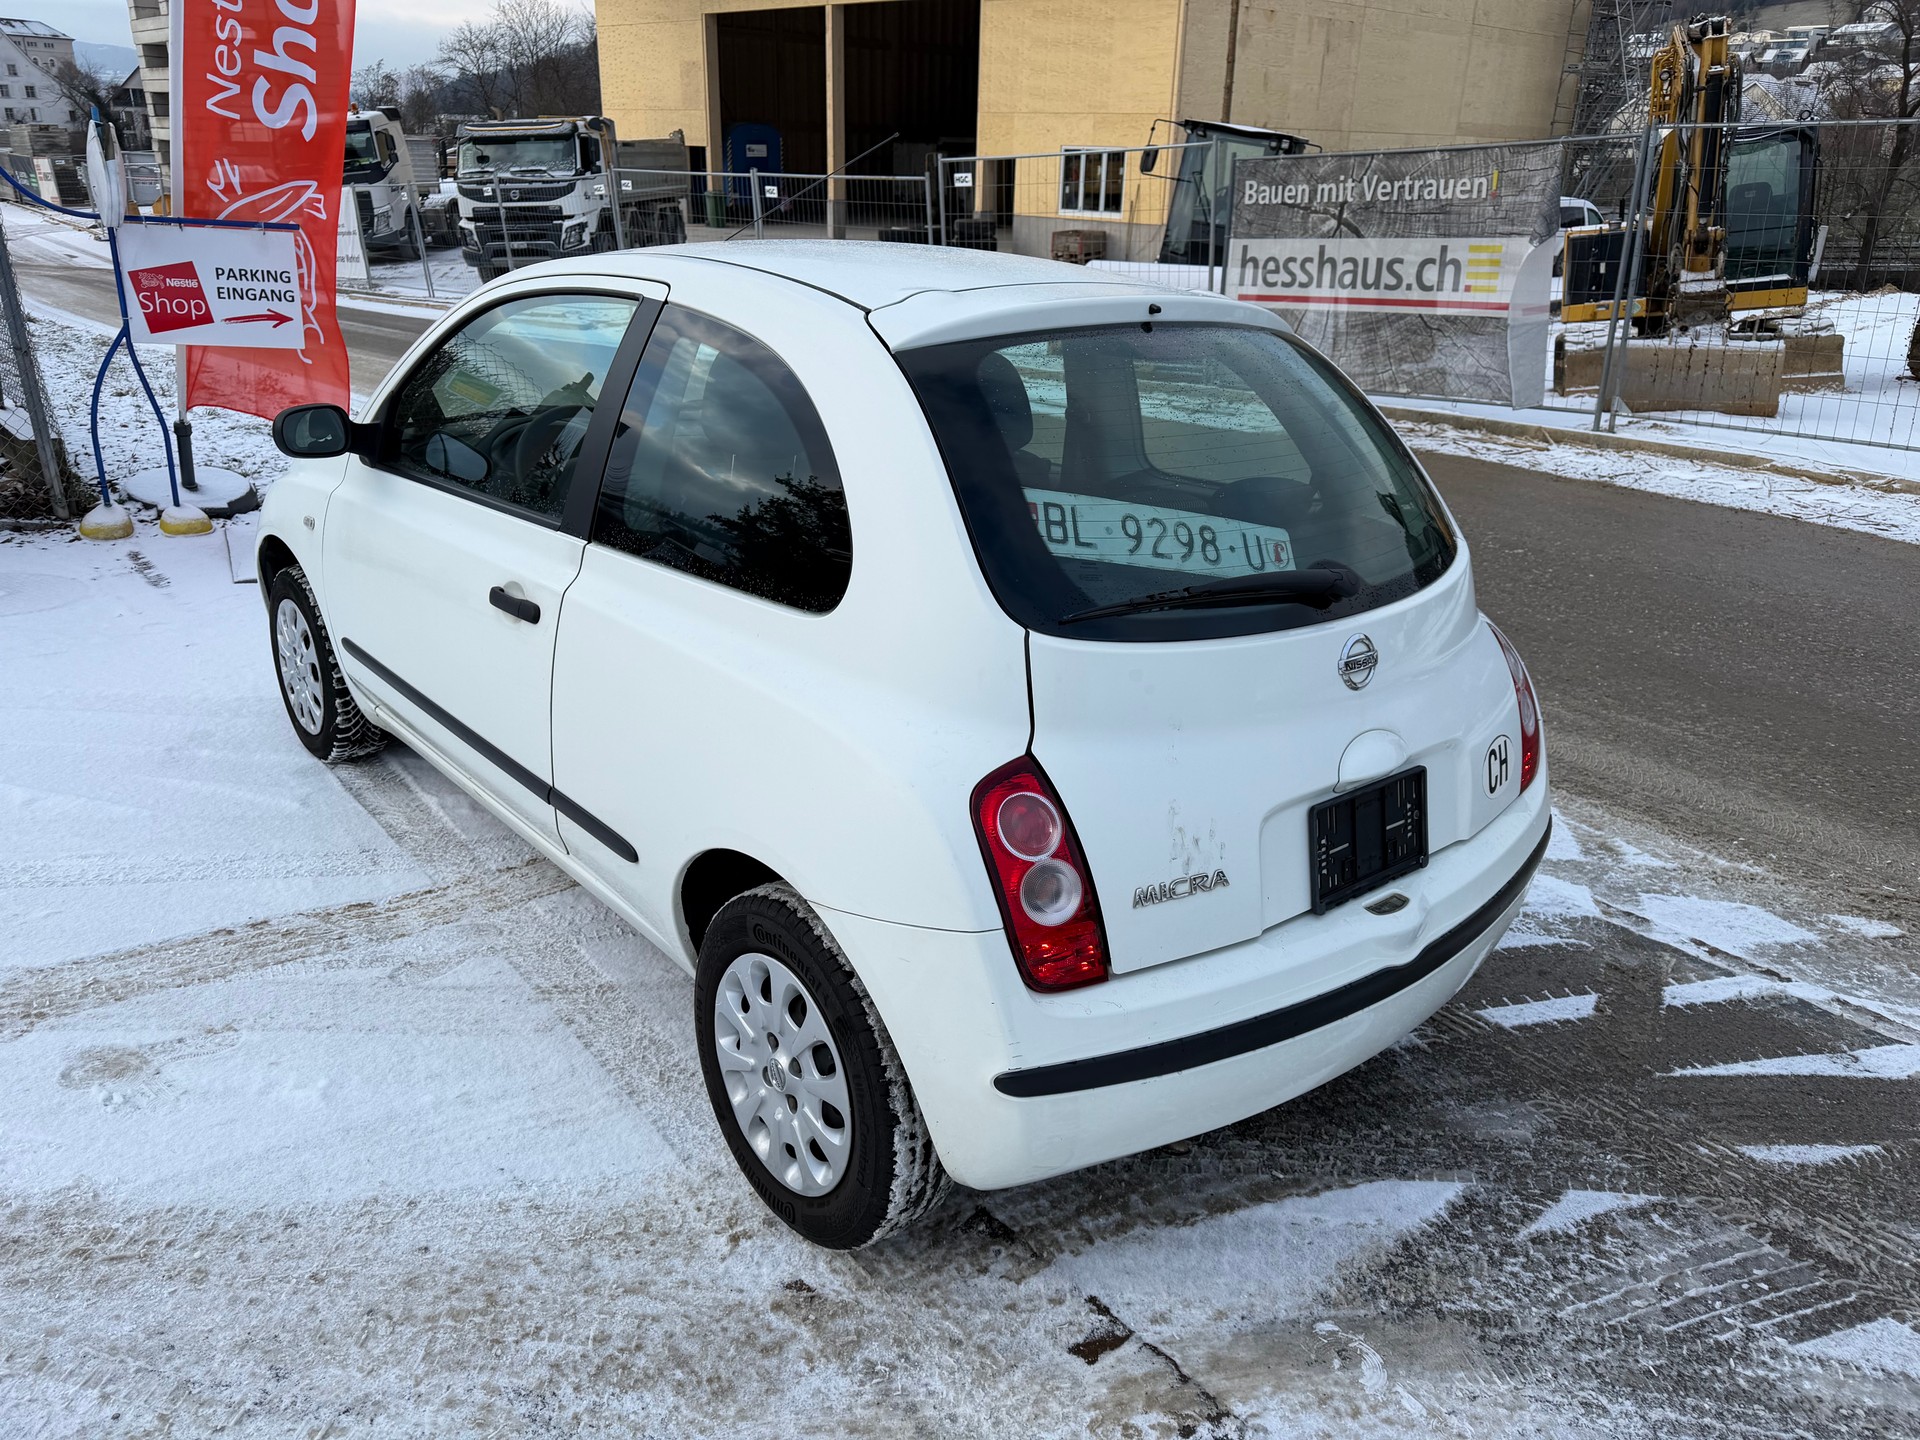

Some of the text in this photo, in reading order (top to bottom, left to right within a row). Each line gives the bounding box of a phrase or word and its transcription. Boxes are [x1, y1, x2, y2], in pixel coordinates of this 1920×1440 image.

[1244, 169, 1499, 205] Bauen mit Vertrauen!
[215, 267, 292, 284] PARKING
[1238, 244, 1462, 293] hesshaus.ch
[139, 291, 206, 320] Shop
[216, 286, 295, 303] EINGANG
[1043, 501, 1266, 571] BL 9298 U
[1345, 653, 1377, 671] NISSAN
[1488, 739, 1508, 794] CH
[1132, 869, 1230, 909] MICRA
[752, 922, 821, 990] Continental
